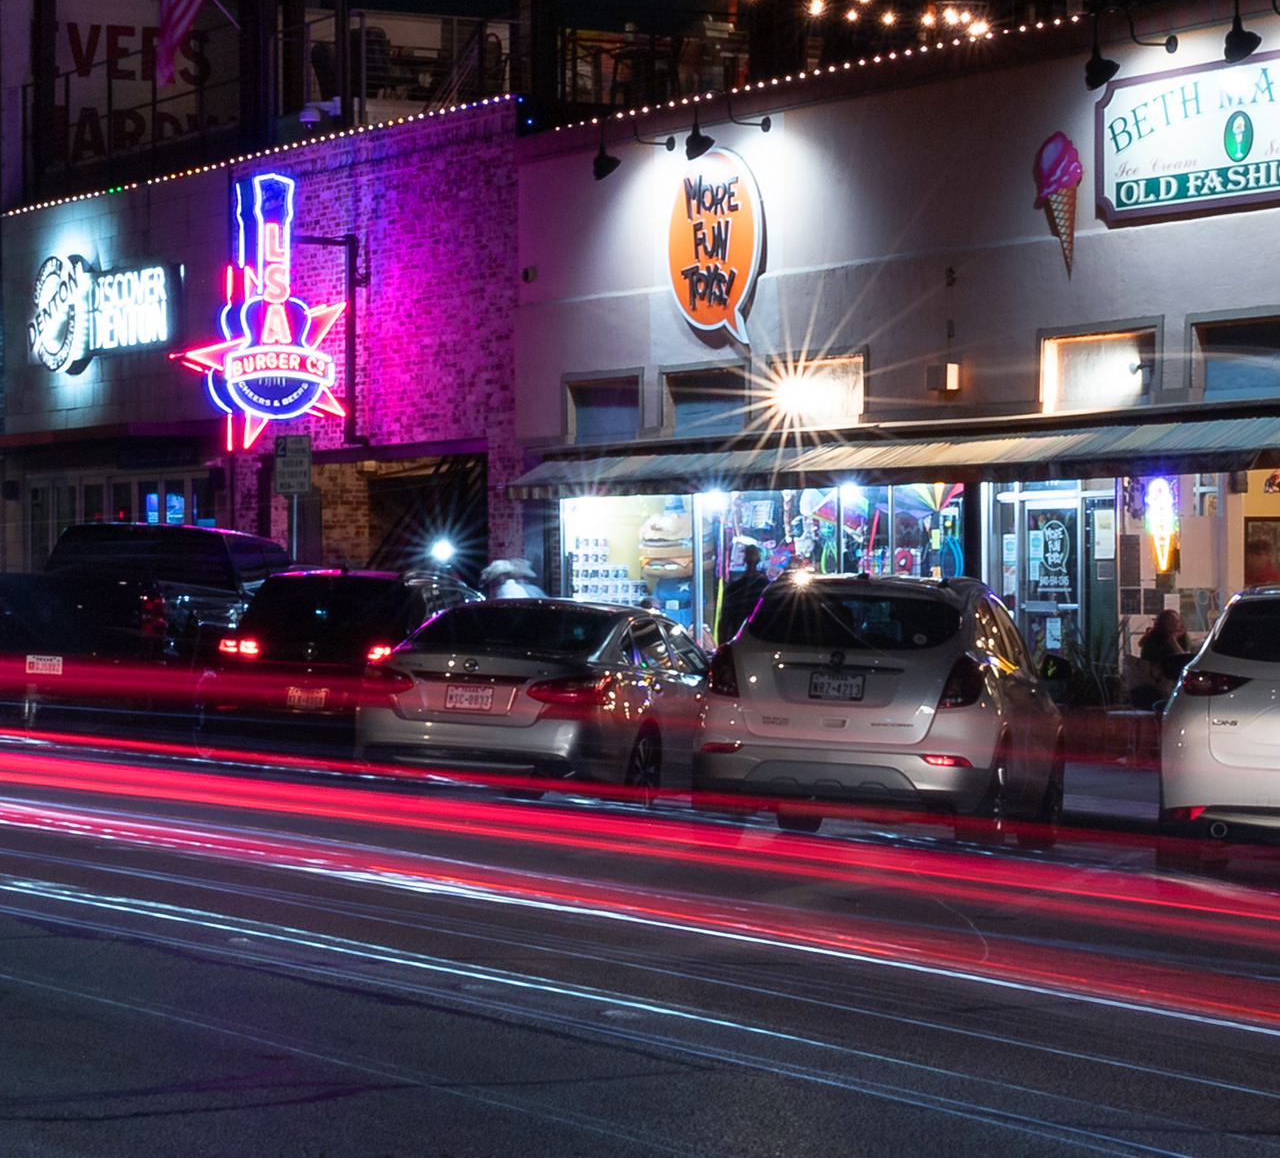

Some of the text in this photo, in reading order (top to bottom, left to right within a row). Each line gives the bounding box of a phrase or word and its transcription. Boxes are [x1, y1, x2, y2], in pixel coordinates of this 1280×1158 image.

[1108, 81, 1202, 155] BETH
[1115, 158, 1140, 178] Ice
[1150, 156, 1198, 174] Cream
[683, 175, 739, 221] MORE
[1120, 175, 1178, 204] OLD
[693, 220, 730, 263] FUN
[89, 267, 167, 311] DISCOVER
[27, 269, 78, 353] DENTON
[89, 300, 168, 350] DENTON
[232, 352, 301, 377] BURGER
[238, 381, 309, 407] CHEERS & BEERS
[277, 438, 285, 455] 2
[1045, 528, 1064, 540] MORE
[1048, 540, 1062, 553] FUN
